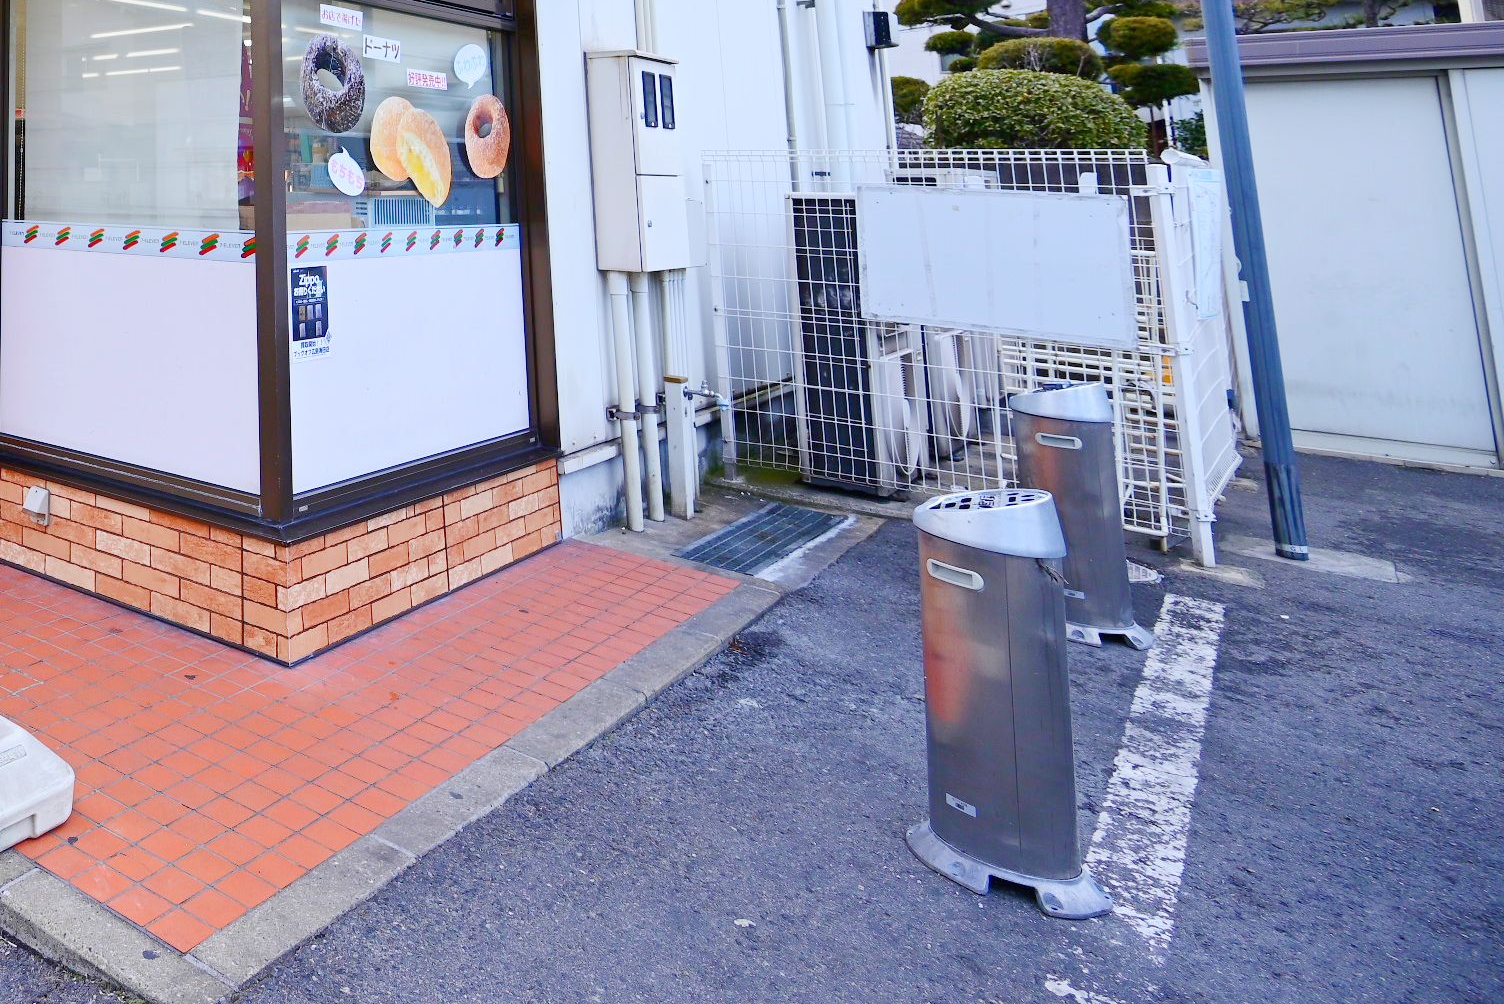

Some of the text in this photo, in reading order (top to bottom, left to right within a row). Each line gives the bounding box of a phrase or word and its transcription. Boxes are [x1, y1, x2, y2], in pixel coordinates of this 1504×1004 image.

[364, 36, 401, 59] ドーナツ
[331, 159, 364, 189] もちもち
[298, 273, 320, 287] Zippo
